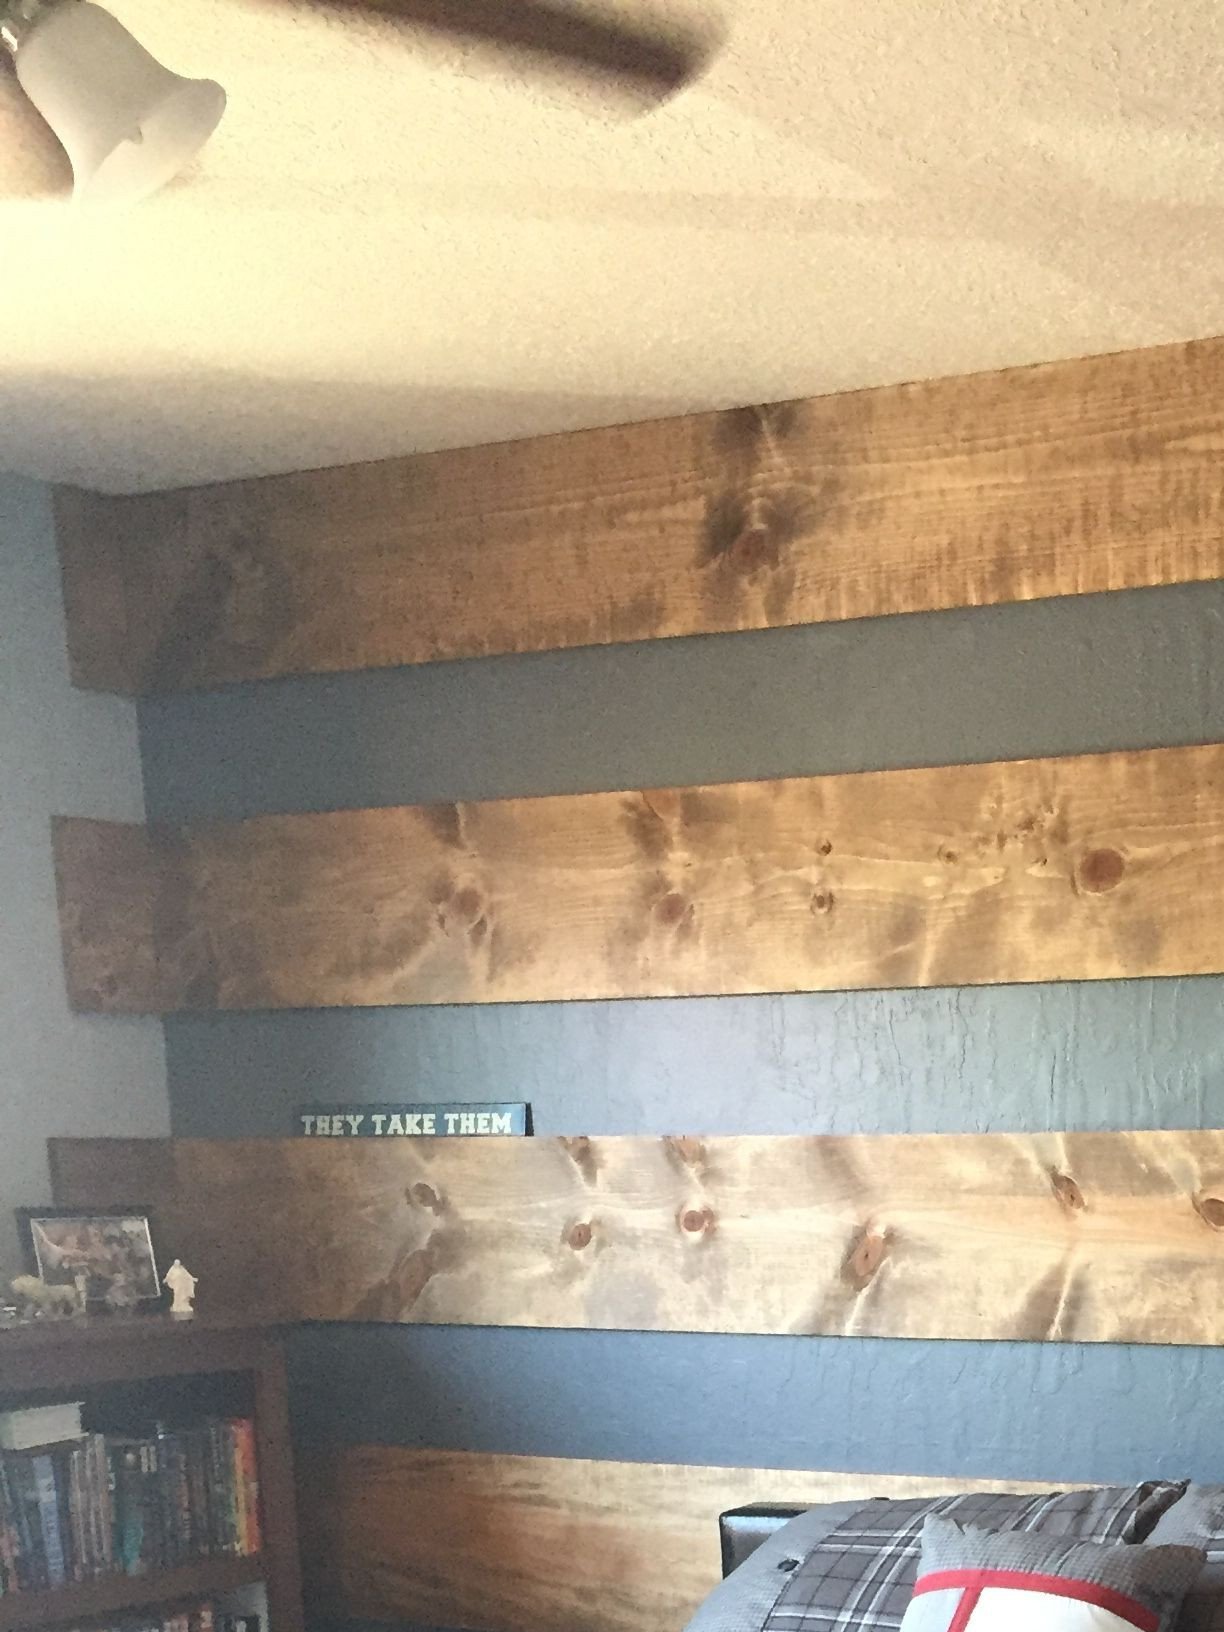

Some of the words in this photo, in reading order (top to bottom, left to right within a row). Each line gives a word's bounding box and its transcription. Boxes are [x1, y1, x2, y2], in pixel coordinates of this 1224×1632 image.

[301, 1115, 364, 1135] THEY
[372, 1114, 436, 1135] TAKE
[444, 1112, 512, 1134] THEM
